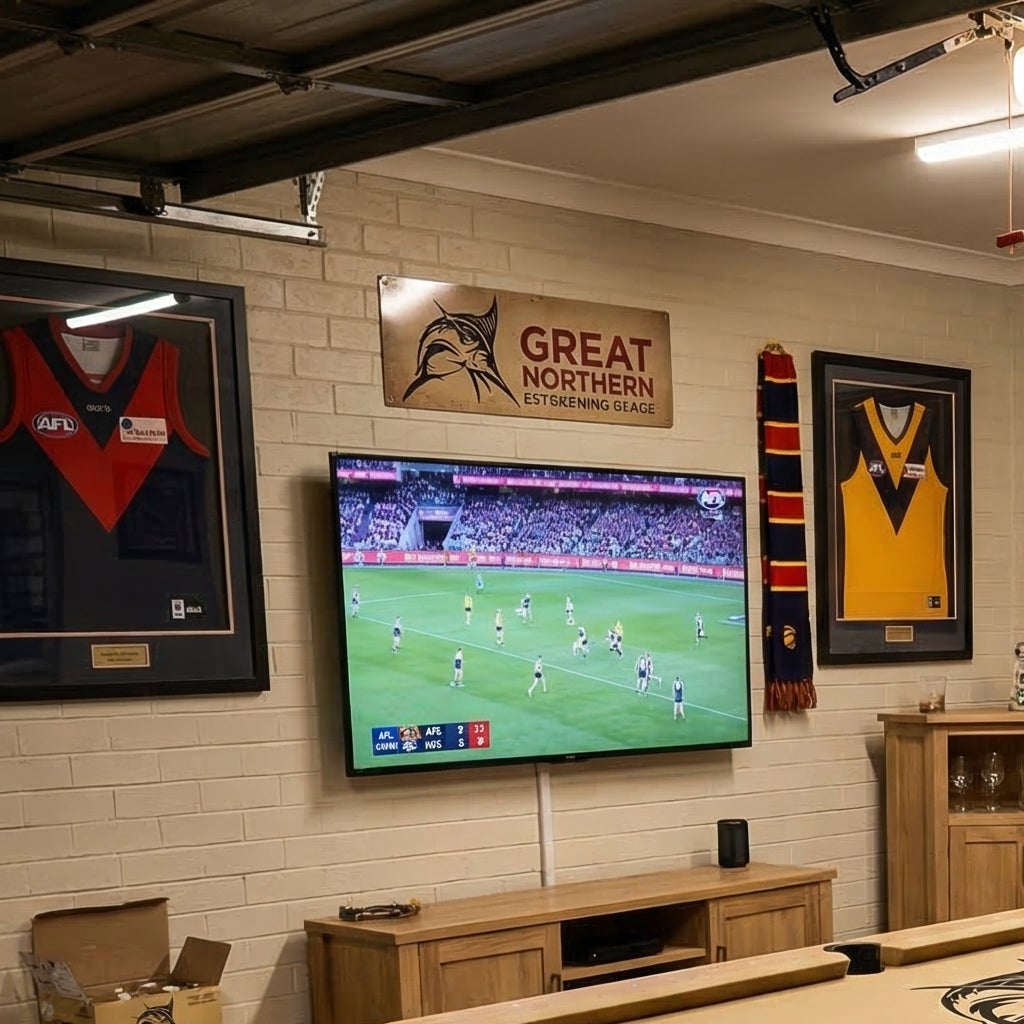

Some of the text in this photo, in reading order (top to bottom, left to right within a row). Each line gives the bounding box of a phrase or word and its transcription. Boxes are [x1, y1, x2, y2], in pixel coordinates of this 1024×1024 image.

[520, 325, 652, 372] GREAT
[522, 365, 654, 398] NORTHERN
[36, 416, 75, 431] AFL
